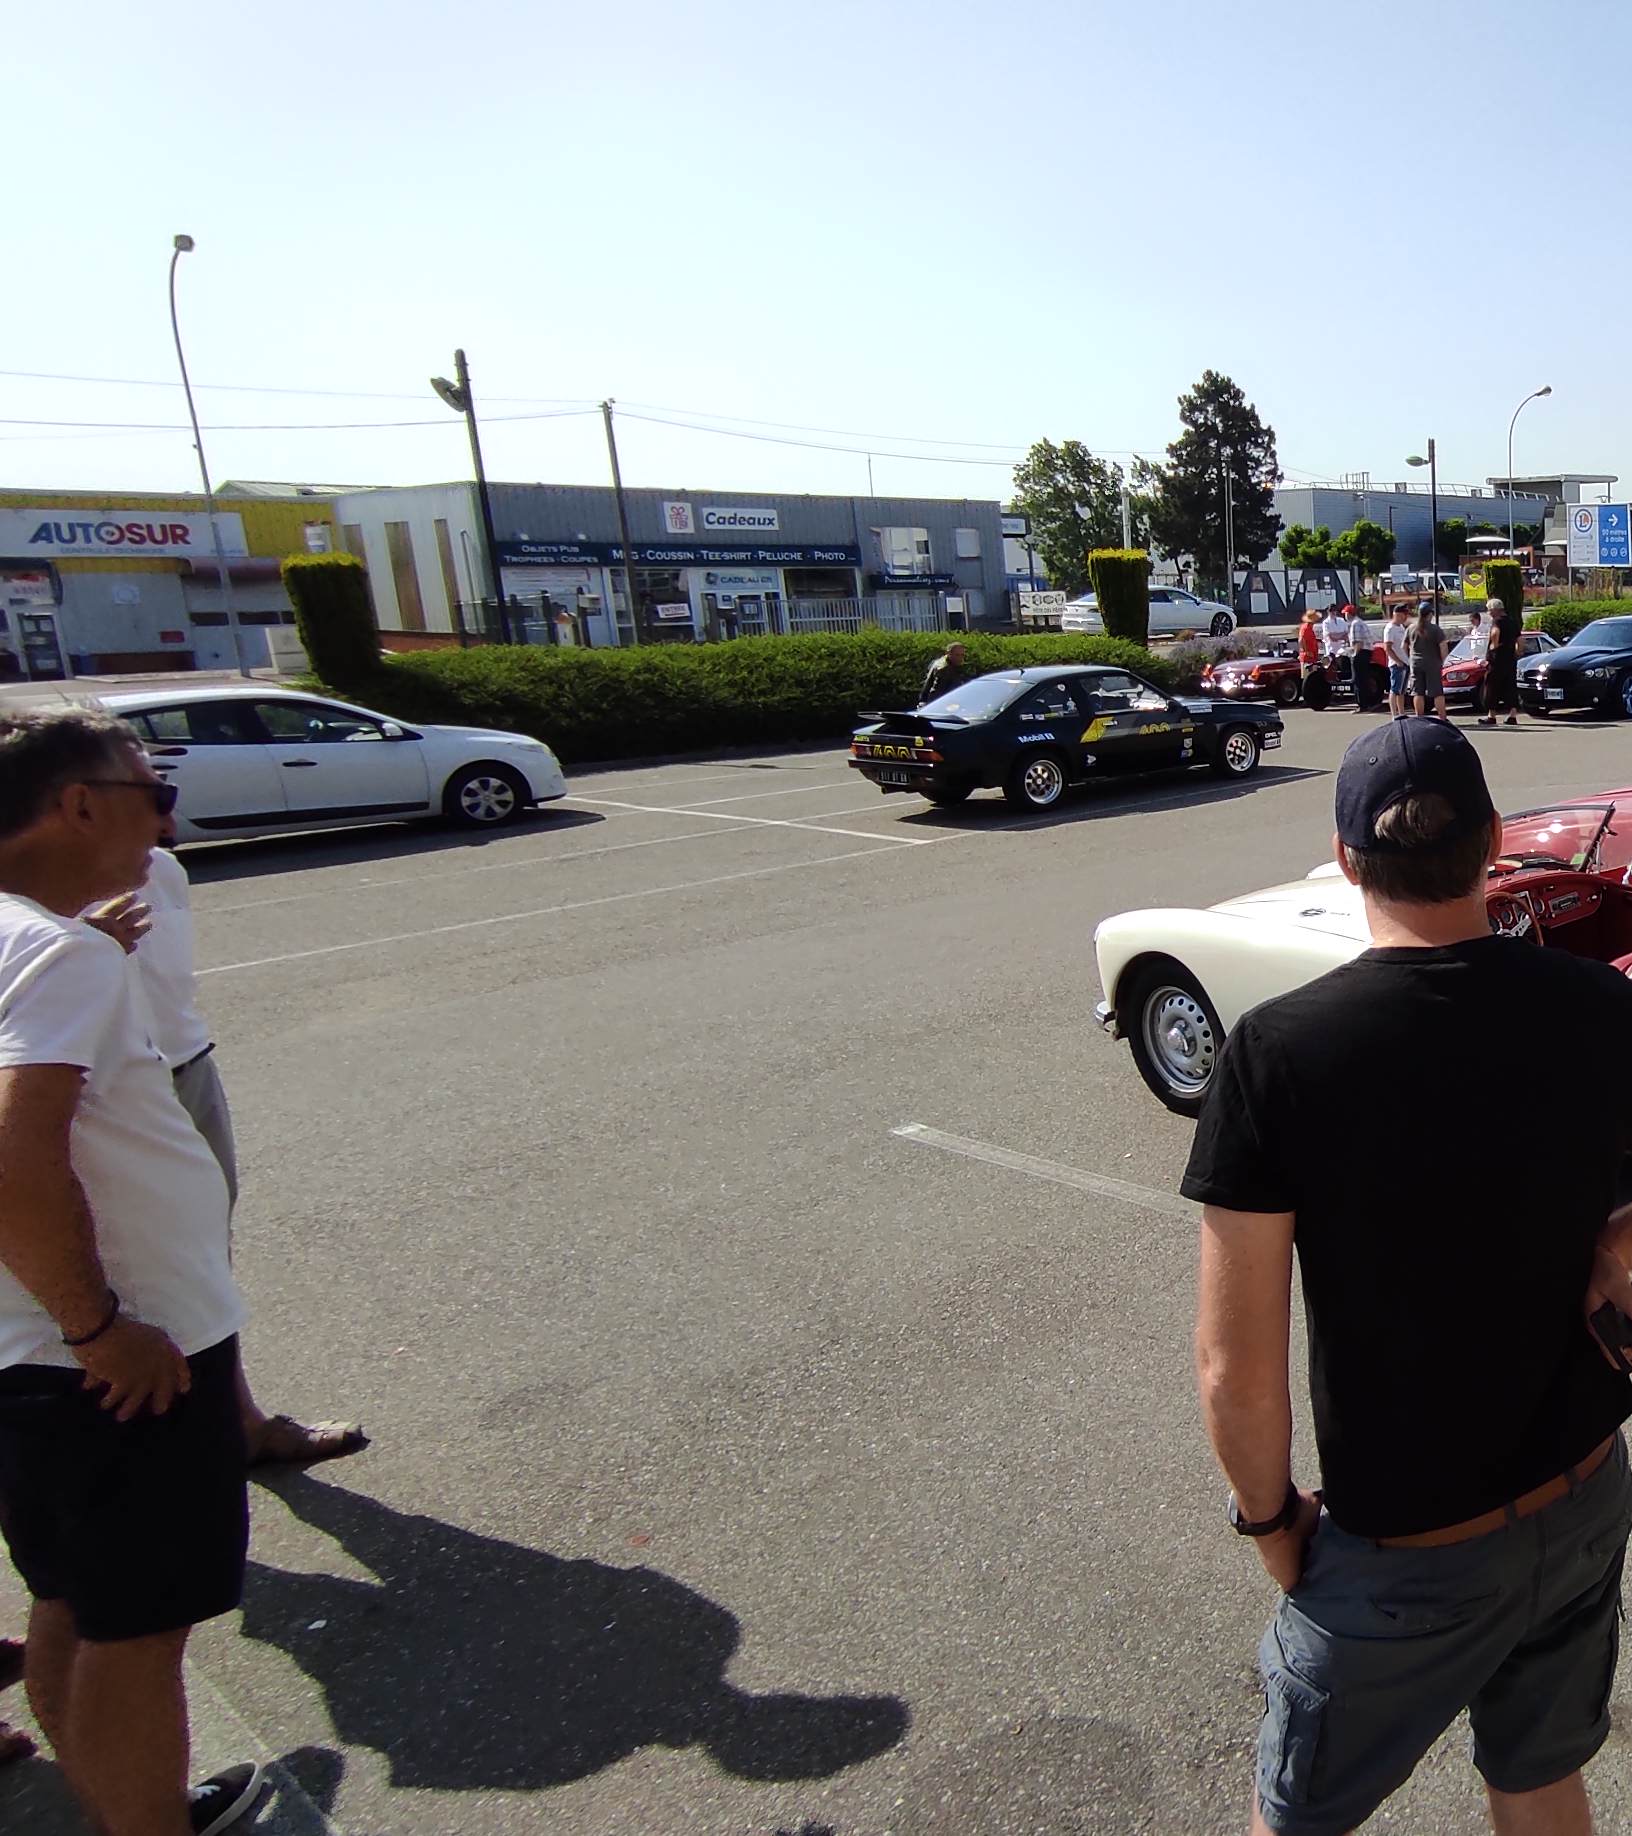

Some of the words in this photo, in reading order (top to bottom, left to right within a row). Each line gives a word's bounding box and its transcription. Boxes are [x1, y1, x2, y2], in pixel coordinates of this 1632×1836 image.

[705, 512, 775, 526] Cadeaux
[28, 521, 192, 546] AUTOSUR
[560, 545, 579, 553] PUB
[612, 550, 639, 560] MG
[646, 550, 694, 561] COUSSIN
[702, 550, 752, 560] TEE-SHIRT
[758, 550, 803, 560] PELUCHE
[814, 551, 846, 560] PHOTO
[1018, 732, 1046, 743] Mobil
